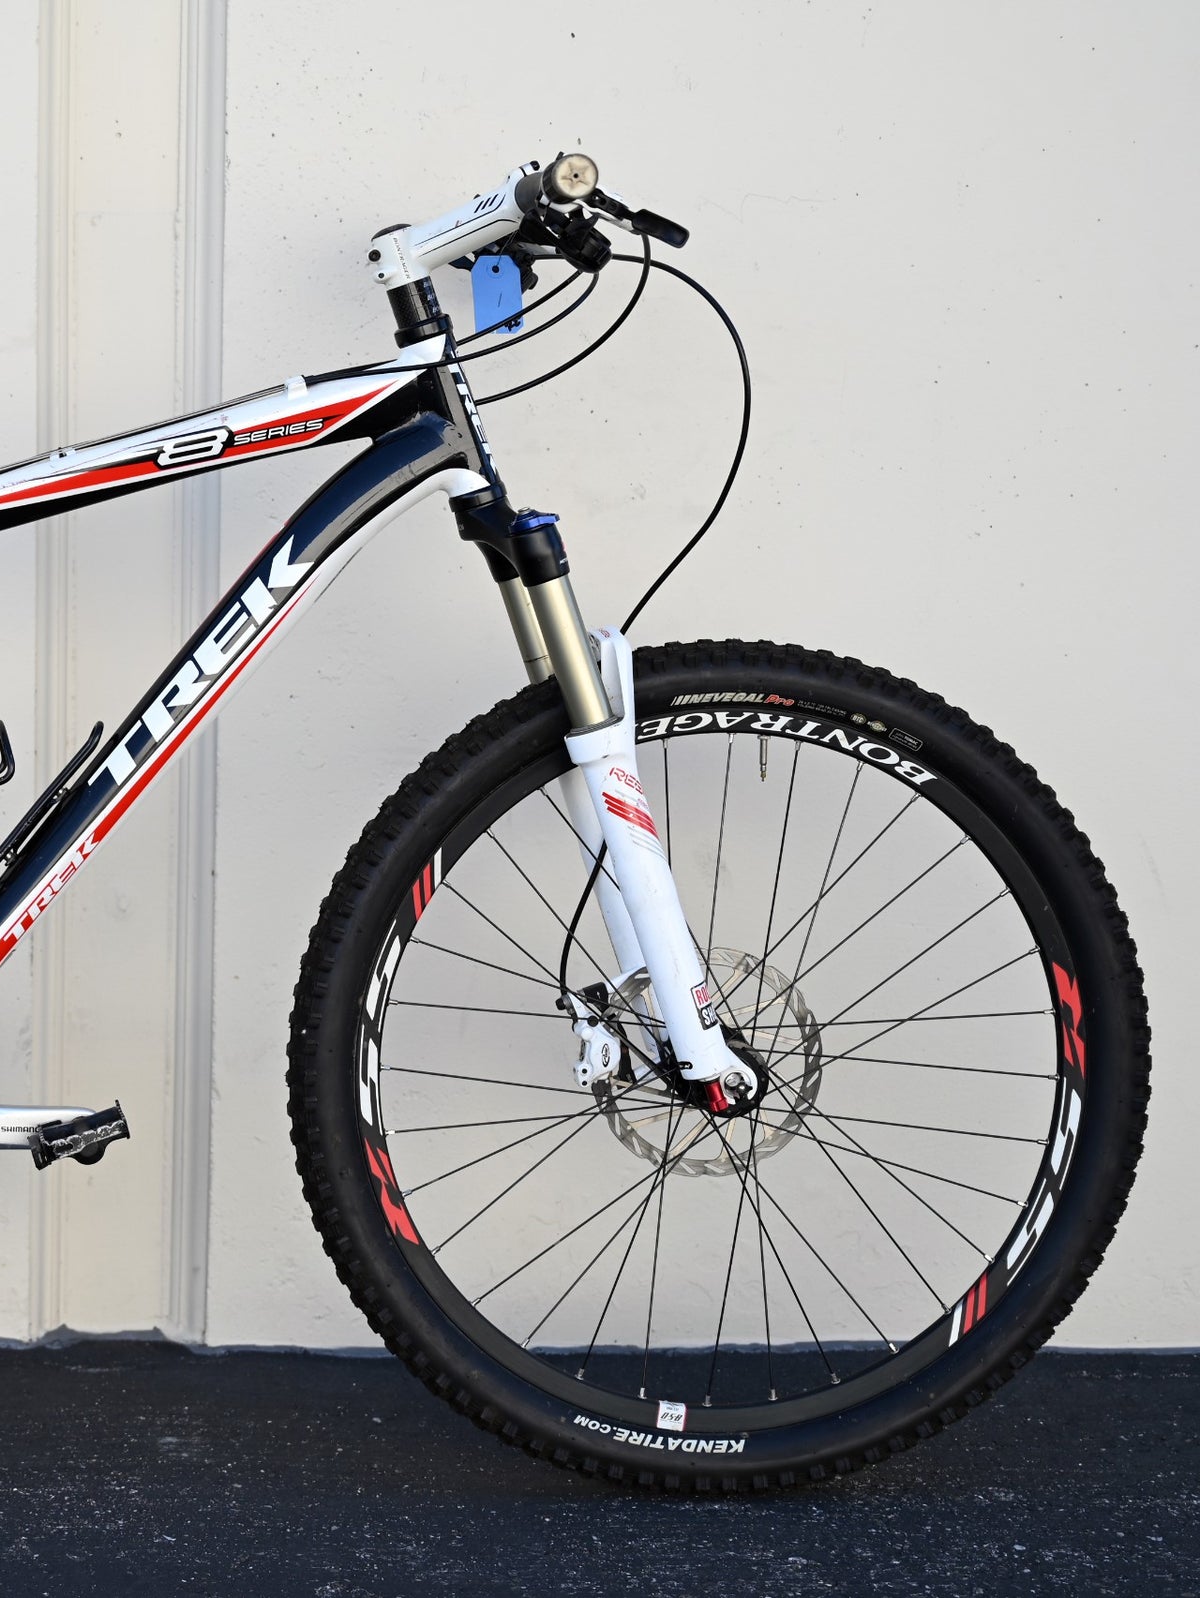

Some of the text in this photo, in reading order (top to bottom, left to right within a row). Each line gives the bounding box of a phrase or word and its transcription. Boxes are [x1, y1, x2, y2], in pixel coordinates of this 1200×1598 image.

[156, 418, 325, 468] 8 SERIES
[88, 534, 315, 788] TREK
[688, 692, 795, 706] NEVEGAL Pro
[635, 711, 939, 787] BONTRAGE
[3, 831, 101, 942] TREK
[573, 1414, 746, 1454] KENDATIRE.COM
